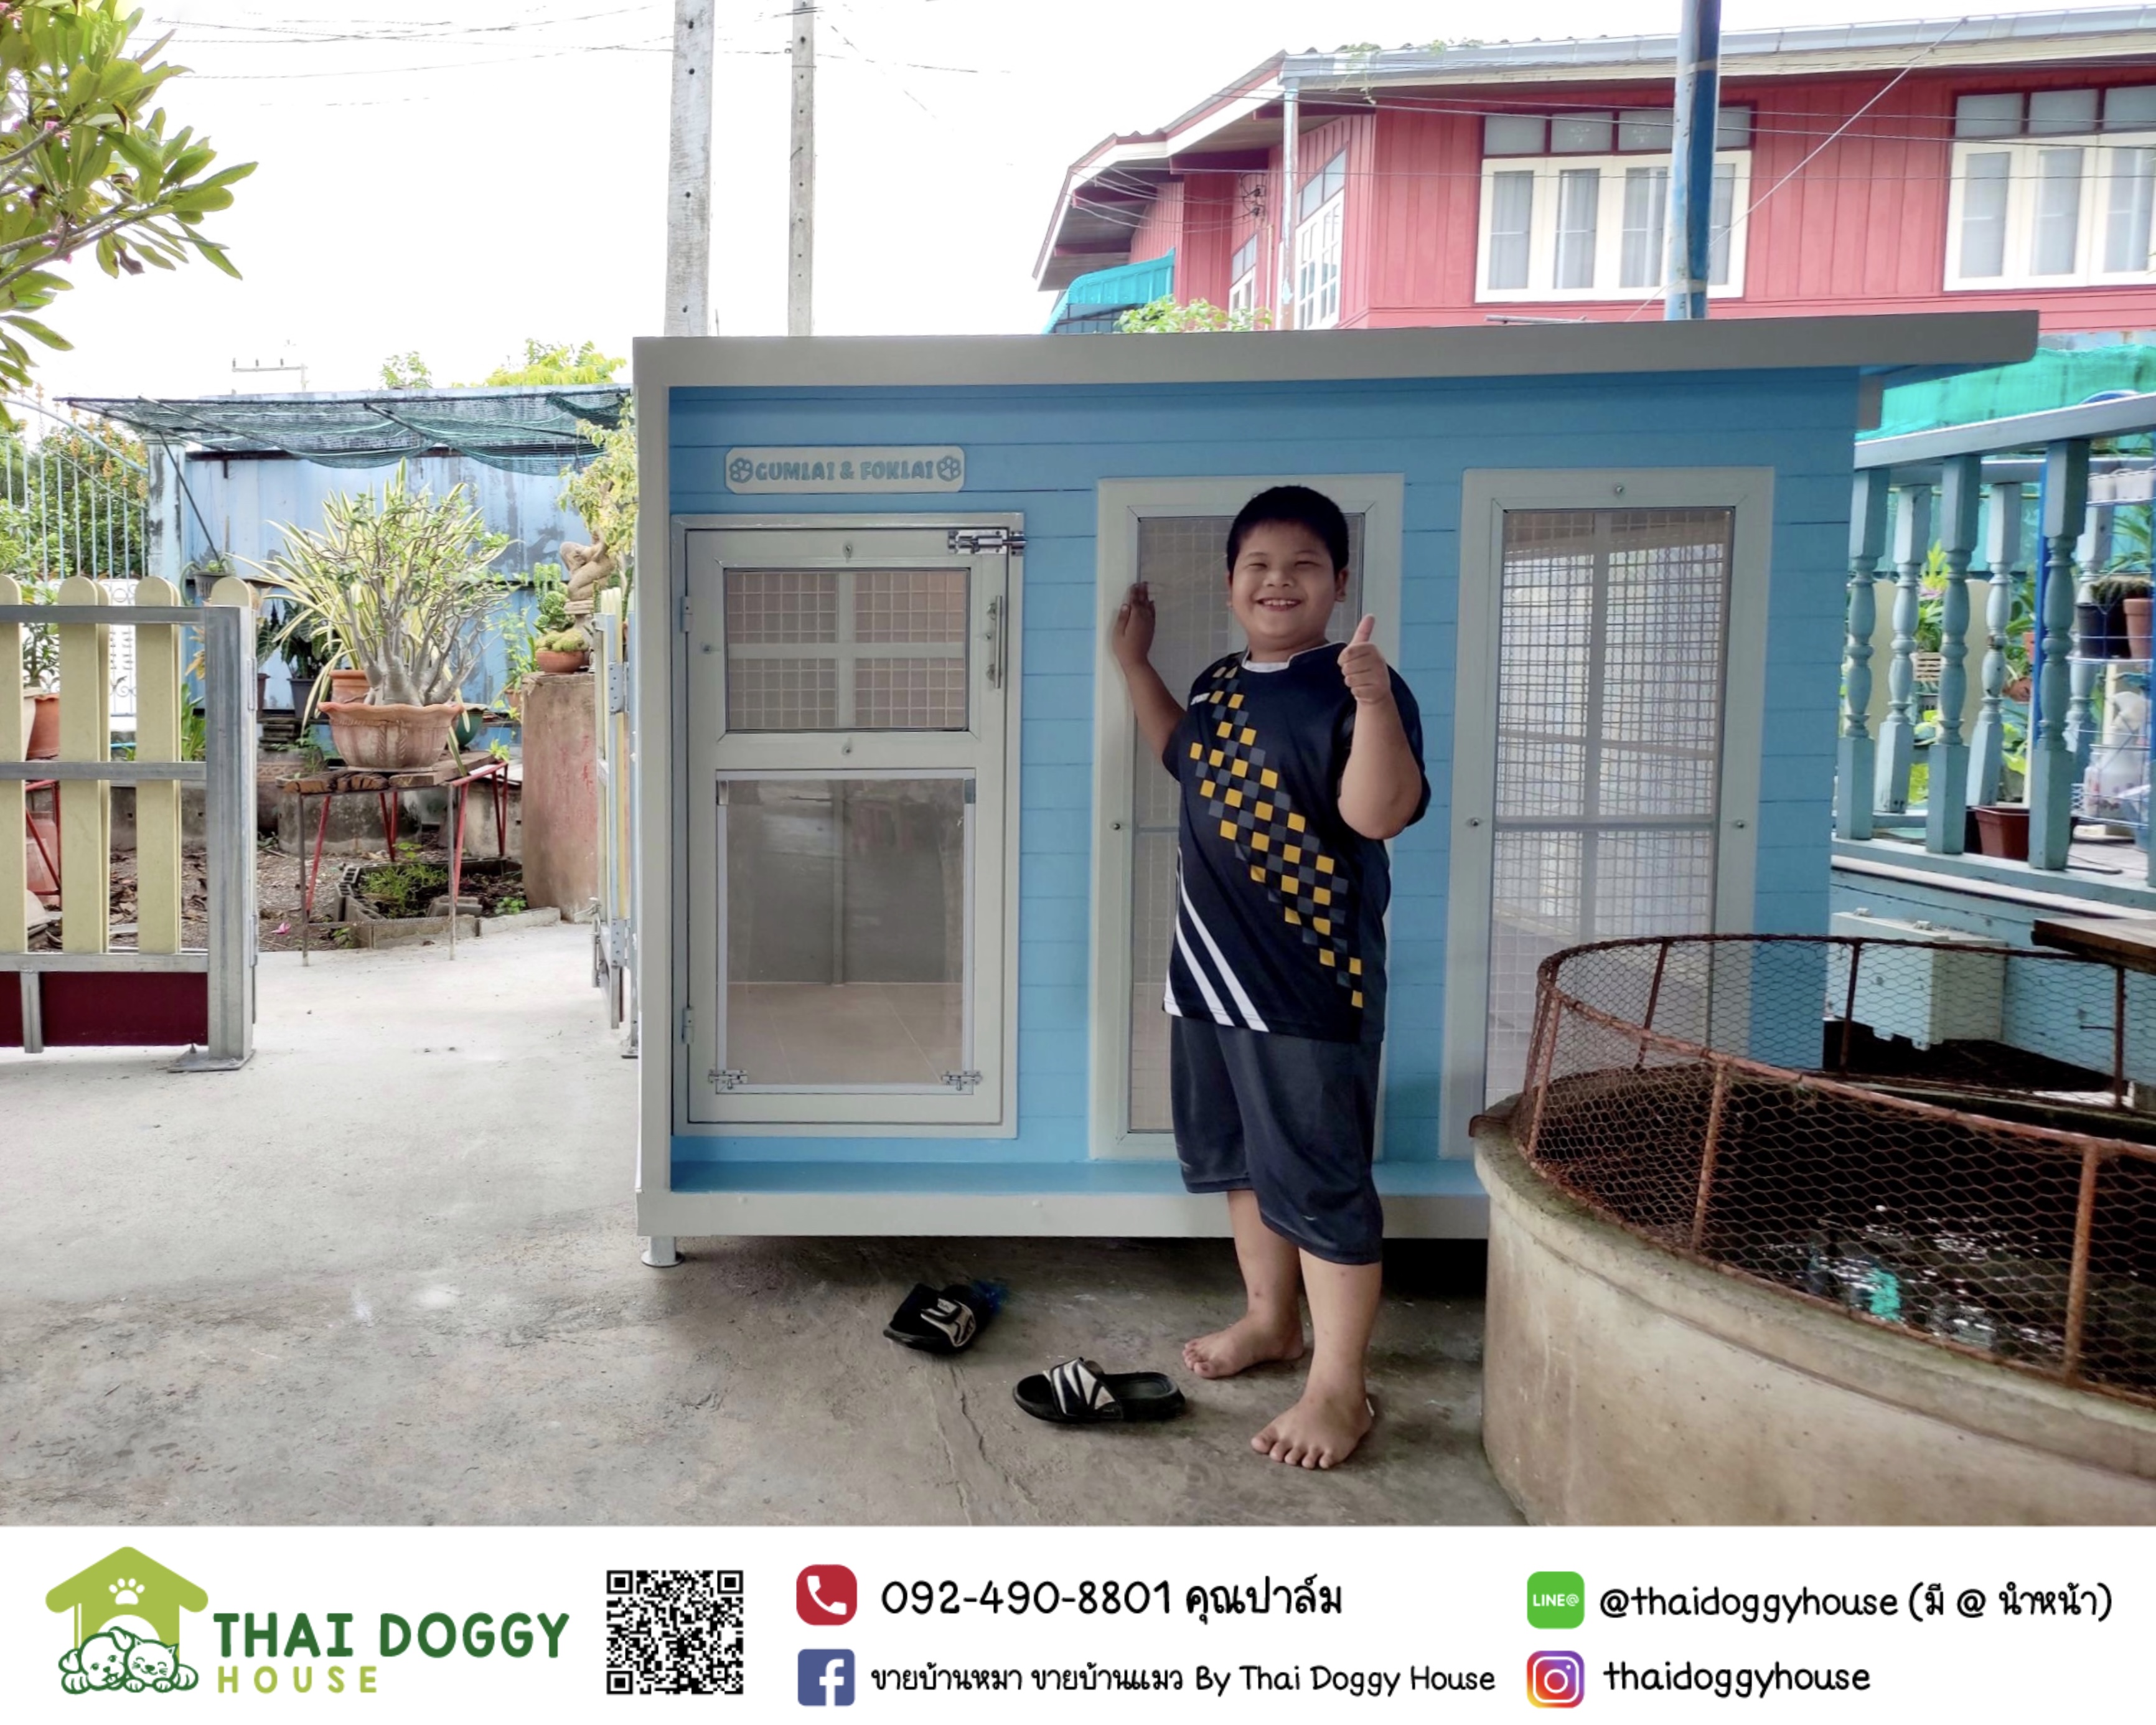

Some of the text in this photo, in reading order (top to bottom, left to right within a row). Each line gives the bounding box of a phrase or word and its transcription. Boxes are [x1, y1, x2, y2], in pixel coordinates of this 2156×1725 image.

[754, 460, 934, 481] GUMLAI & FOKLAI
